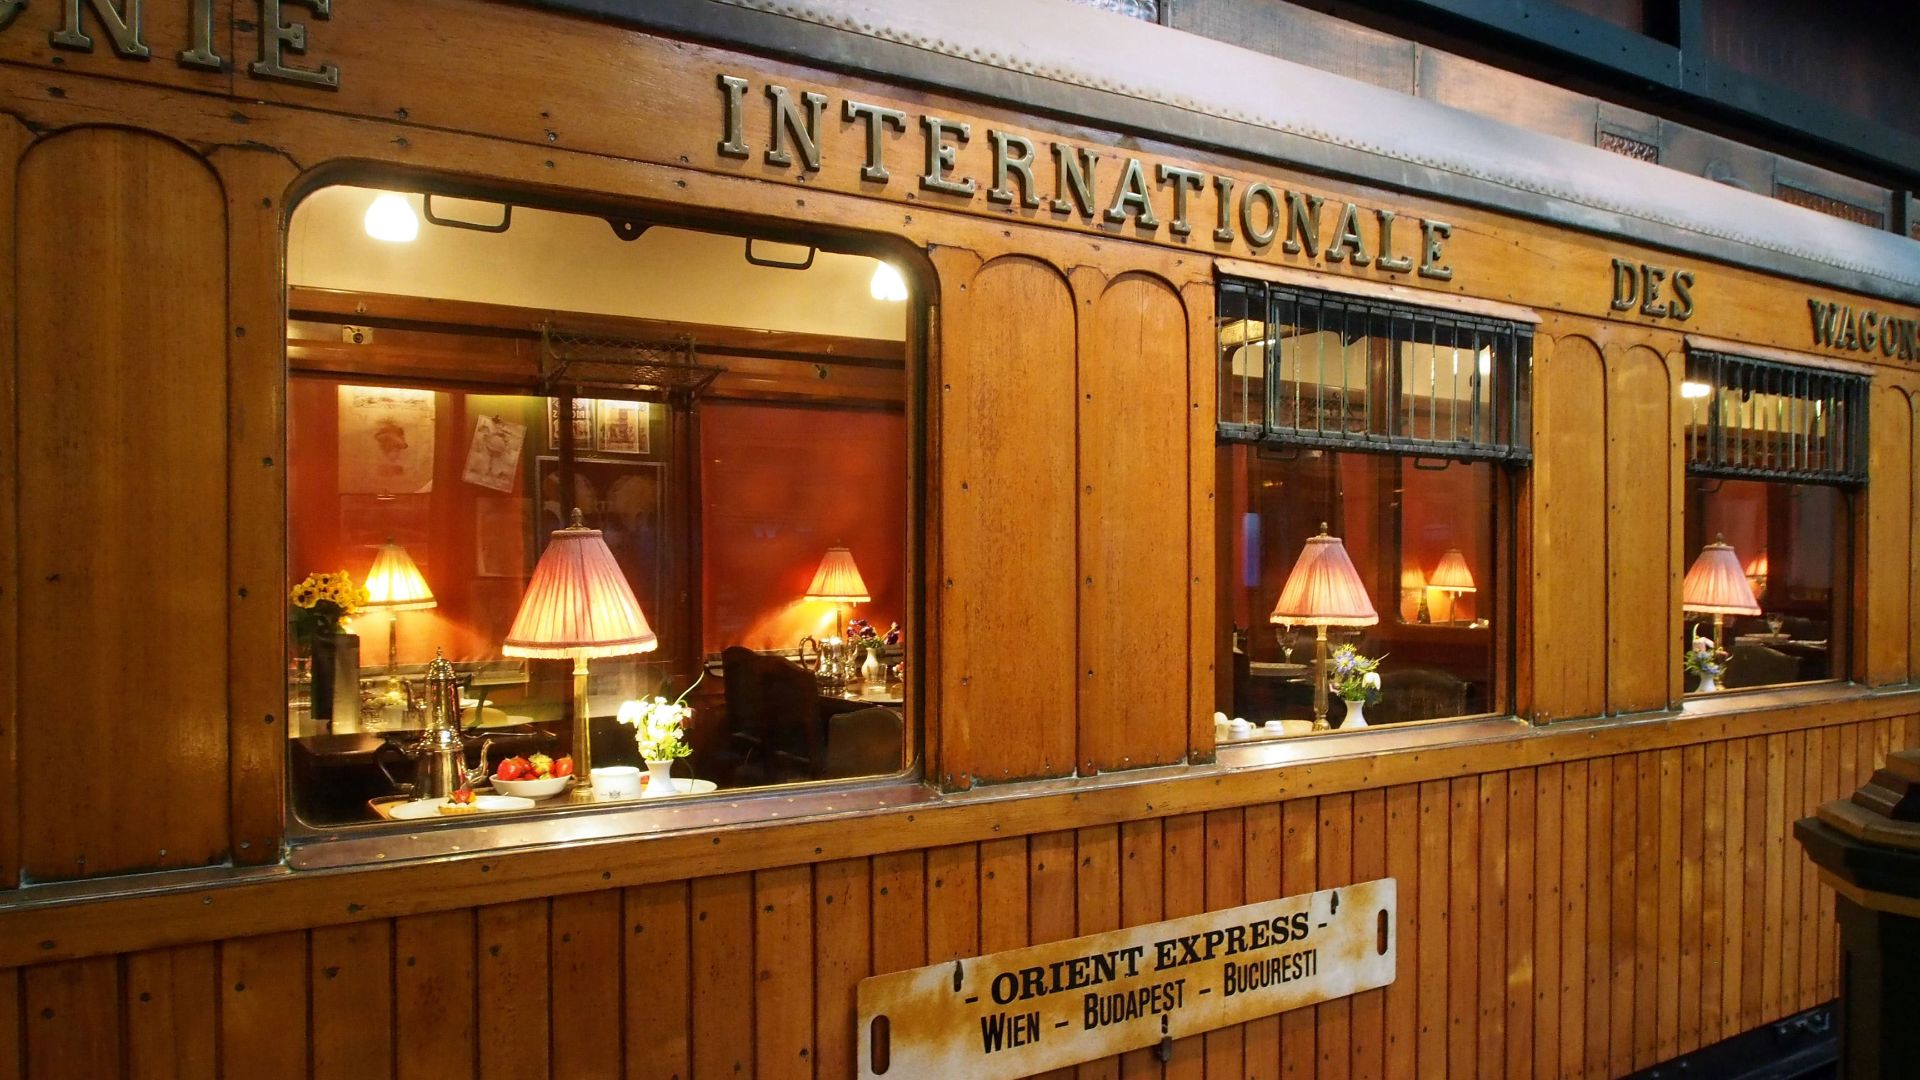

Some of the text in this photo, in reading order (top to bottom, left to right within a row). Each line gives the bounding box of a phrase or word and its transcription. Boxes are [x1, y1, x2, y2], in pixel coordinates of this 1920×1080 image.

[0, 0, 1920, 362] NIE INTERNATIONALE DES WAGON
[991, 945, 1144, 1005] ORIENT
[1154, 911, 1309, 971] EXPRESS
